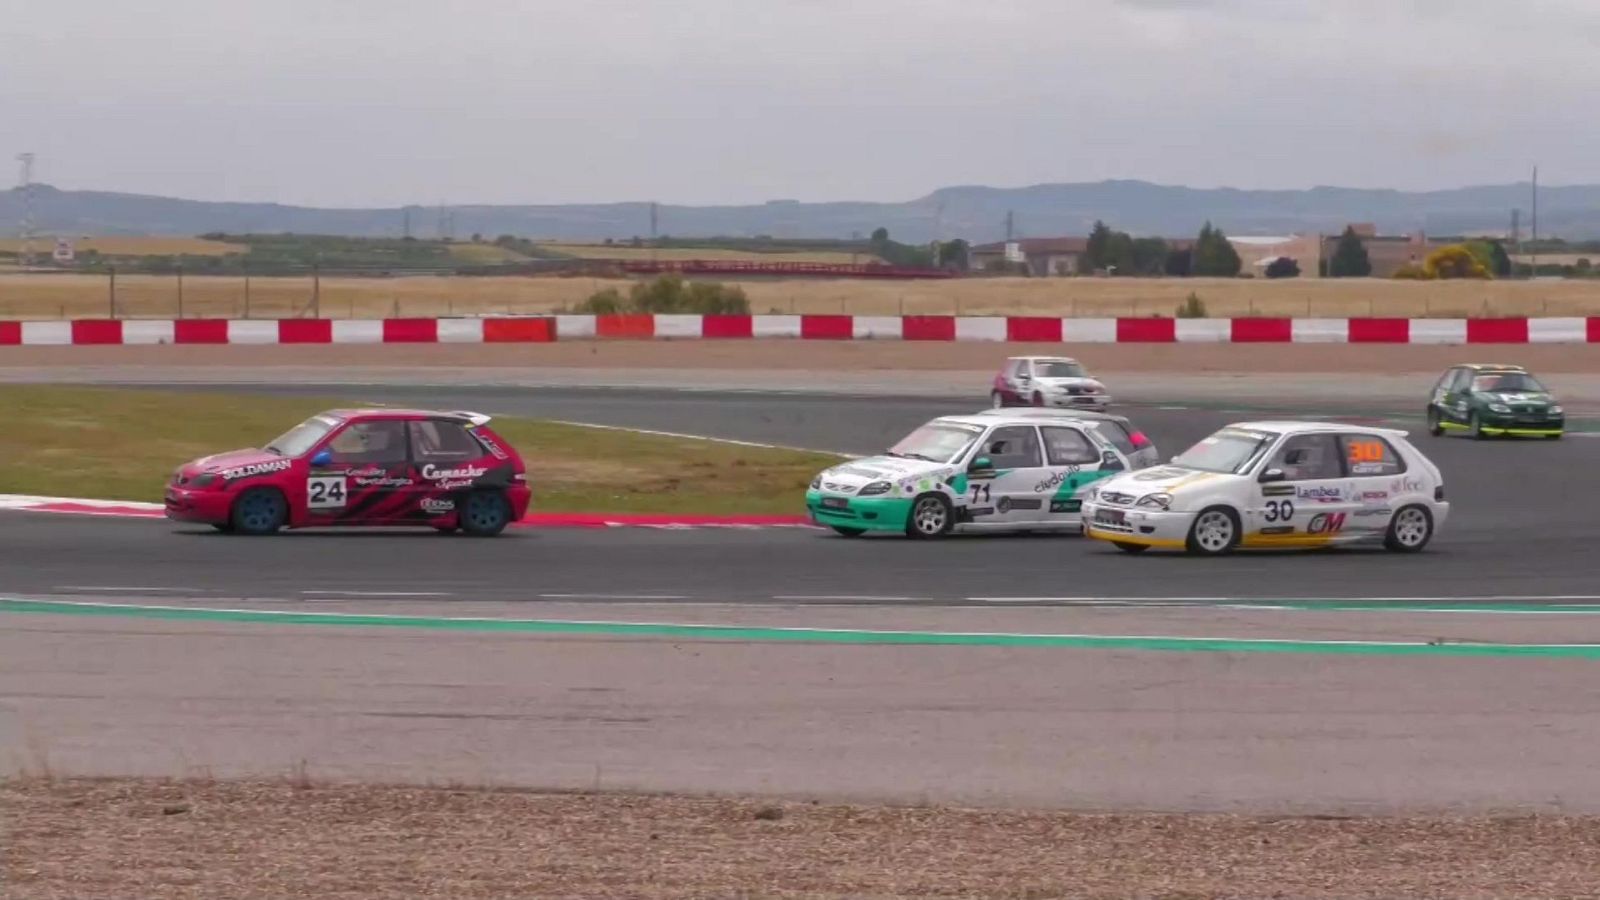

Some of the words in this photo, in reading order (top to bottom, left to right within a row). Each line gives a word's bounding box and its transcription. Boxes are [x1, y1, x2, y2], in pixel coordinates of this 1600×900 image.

[1346, 441, 1383, 464] 30
[310, 481, 344, 503] 24
[970, 483, 991, 505] 71
[1265, 499, 1295, 522] 30
